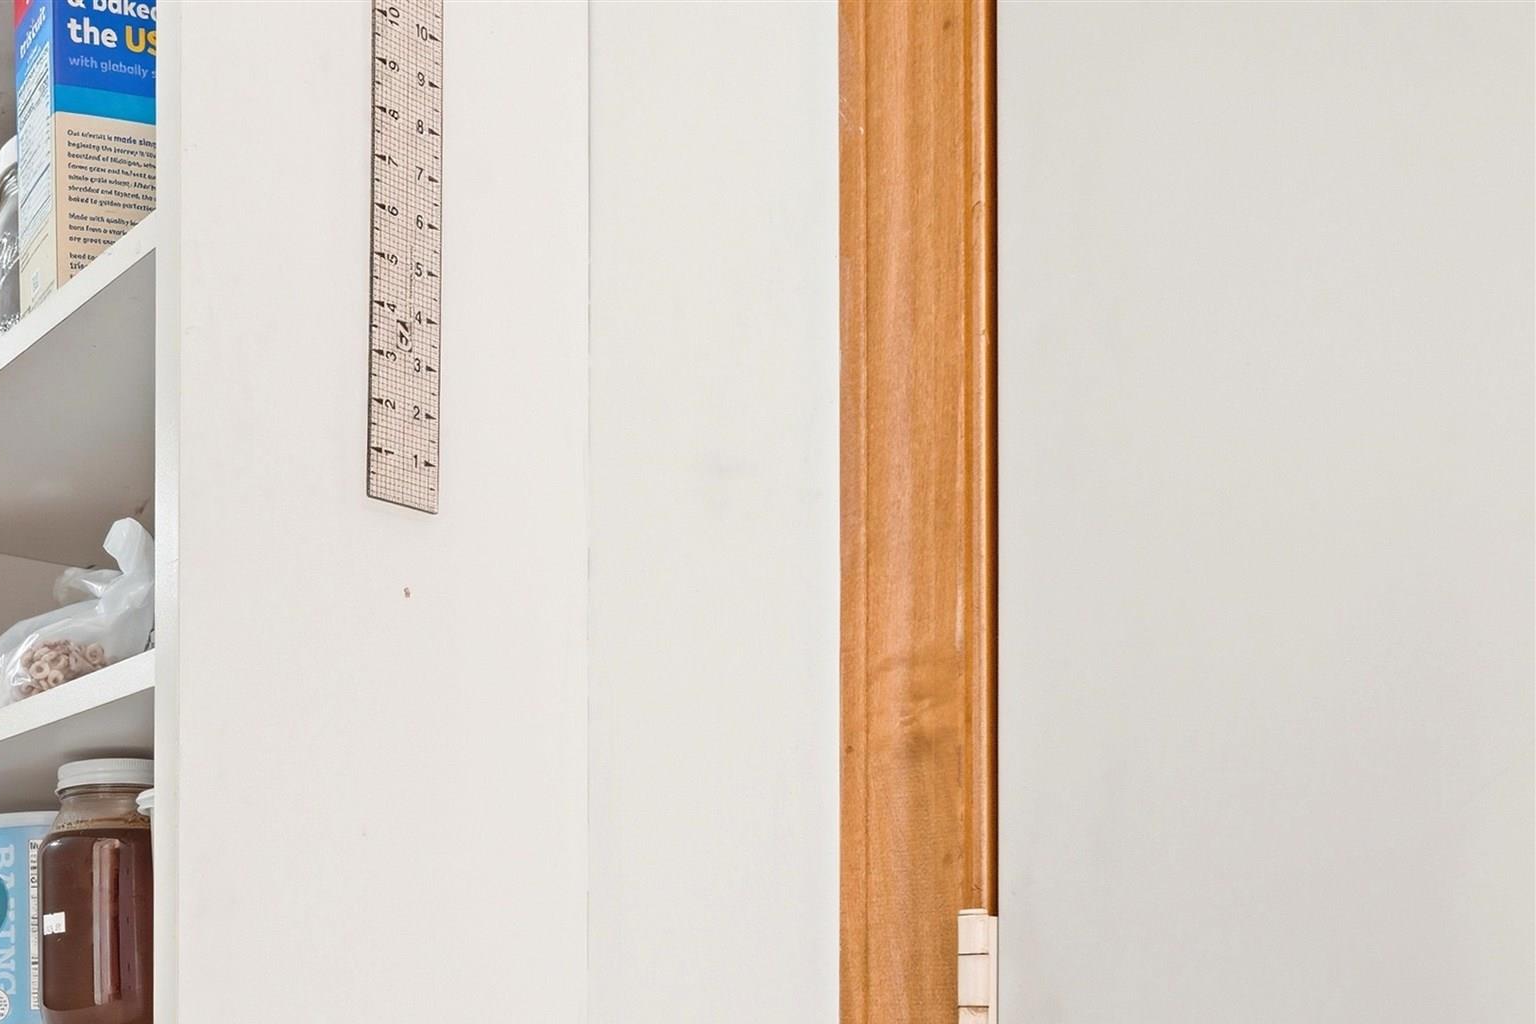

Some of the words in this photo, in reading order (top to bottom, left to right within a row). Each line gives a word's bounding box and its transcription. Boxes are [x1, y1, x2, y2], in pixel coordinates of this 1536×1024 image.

[388, 7, 400, 26] 10
[67, 16, 118, 48] the
[416, 24, 427, 41] 10
[68, 55, 98, 69] with
[100, 60, 148, 78] globally
[388, 60, 400, 72] 9
[418, 72, 425, 87] 9
[388, 109, 399, 120] 8
[417, 119, 424, 134] 8
[388, 155, 398, 167] 7
[416, 166, 424, 180] 7
[388, 206, 399, 216] 6
[416, 214, 423, 230] 6
[388, 254, 398, 265] 5
[415, 262, 422, 277] 5
[386, 302, 396, 312] 4
[415, 311, 422, 324] 4
[386, 350, 397, 361] 3
[414, 358, 420, 372] 3
[384, 399, 396, 410] 2
[413, 406, 420, 420] 2
[413, 454, 418, 468] 1
